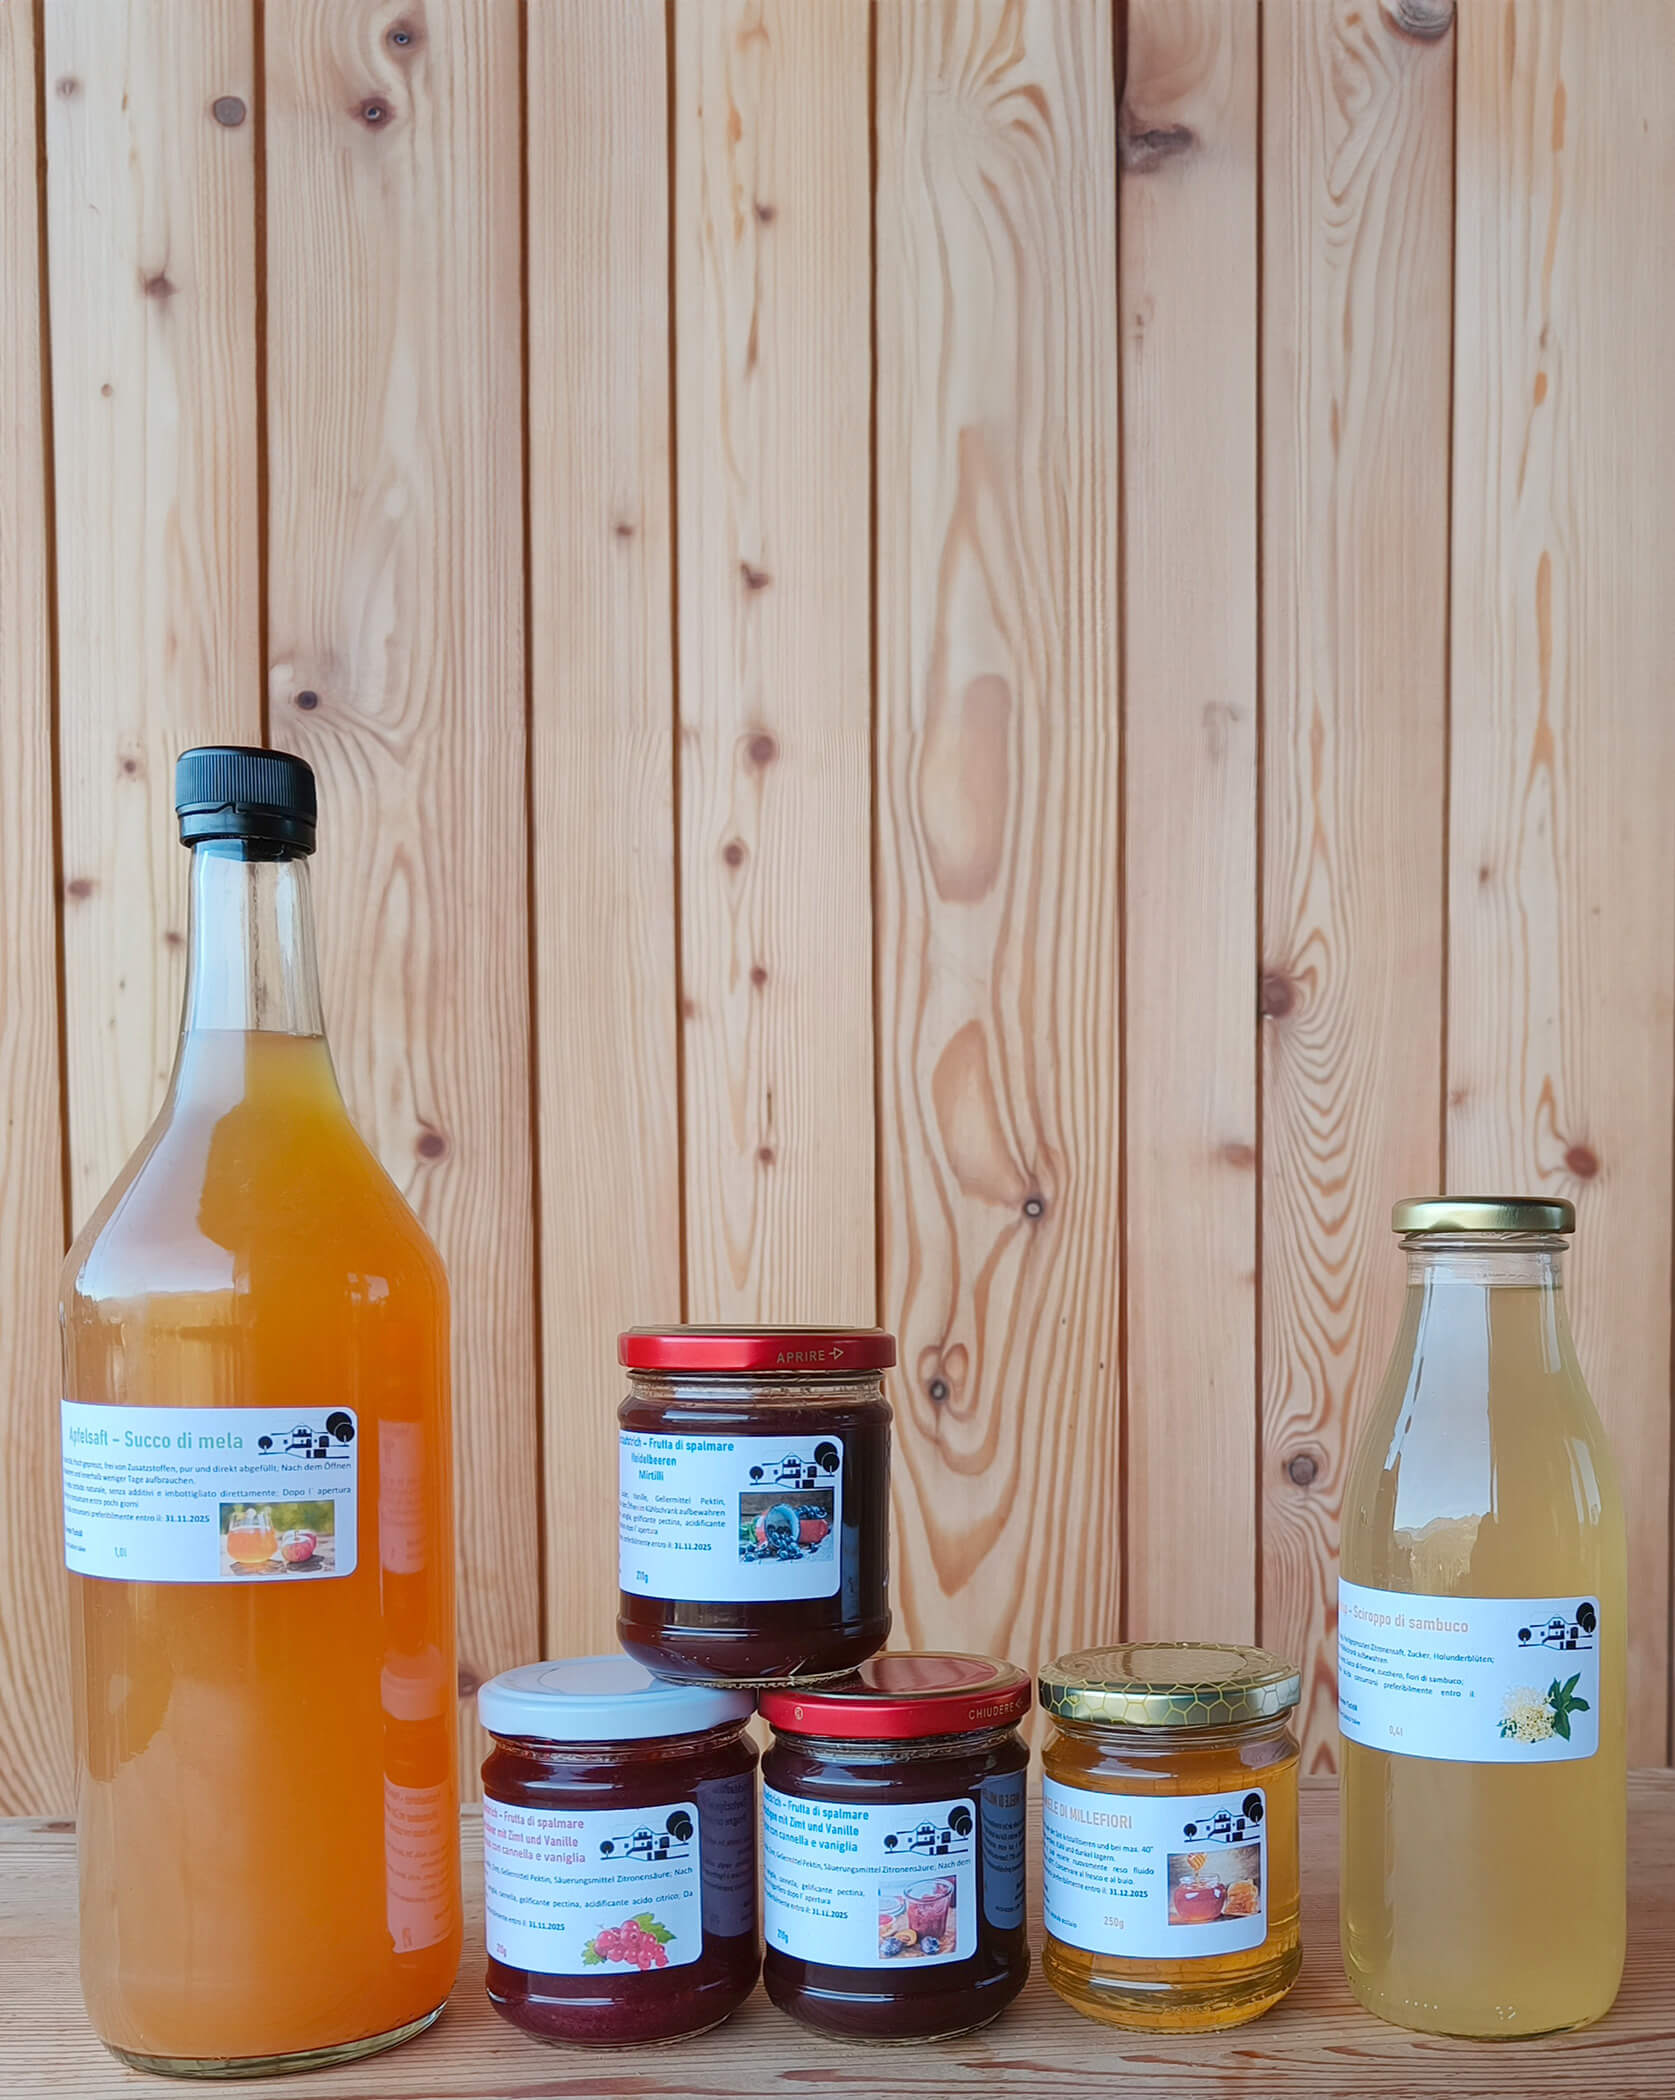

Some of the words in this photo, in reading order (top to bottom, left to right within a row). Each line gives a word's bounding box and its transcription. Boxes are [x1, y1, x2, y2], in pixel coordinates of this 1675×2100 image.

[776, 1350, 825, 1363] APRIRE
[70, 1426, 108, 1447] Apfelsaft
[125, 1430, 171, 1448] Succo
[177, 1432, 193, 1448] di
[199, 1432, 244, 1449] mela
[675, 1440, 684, 1450] di
[686, 1441, 735, 1453] spalmare
[180, 1466, 193, 1475] pur
[195, 1465, 211, 1473] und
[213, 1464, 237, 1473] direkt
[282, 1463, 304, 1472] Nach
[304, 1462, 322, 1471] dem
[324, 1461, 352, 1471] Öffnen
[164, 1489, 217, 1499] imbottigliato
[282, 1488, 305, 1497] Dopo
[317, 1487, 352, 1496] apertura
[165, 1515, 210, 1523] 31.11.2025
[674, 1542, 712, 1551] 31.11.2025
[1353, 1605, 1391, 1628] Sciroppo
[1394, 1613, 1405, 1627] di
[1408, 1618, 1469, 1633] sambuco
[1440, 1689, 1462, 1698] entro
[968, 1702, 1014, 1720] CHIUDERE
[812, 1806, 821, 1816] di
[823, 1808, 869, 1821] spalmare
[1060, 1803, 1068, 1818] DI
[1070, 1807, 1132, 1829] MILLEFIORI
[527, 1816, 535, 1826] di
[537, 1818, 585, 1830] spalmare
[789, 1816, 806, 1830] Zimt
[807, 1822, 824, 1833] und
[825, 1823, 860, 1837] Vanille
[525, 1835, 542, 1845] und
[544, 1836, 579, 1848] Vanille
[811, 1839, 817, 1848] e
[819, 1840, 858, 1854] vaniglia
[536, 1853, 542, 1861] e
[544, 1853, 586, 1865] vaniglia
[938, 1860, 956, 1870] Nach
[674, 1866, 693, 1876] Nach
[1133, 1866, 1154, 1875] fluido
[1109, 1887, 1149, 1898] 31.12.2025
[632, 1896, 653, 1905] acido
[812, 1907, 849, 1919] 31.11.2025
[528, 1920, 566, 1931] 31.11.2025
[1103, 1916, 1124, 1929] 250g
